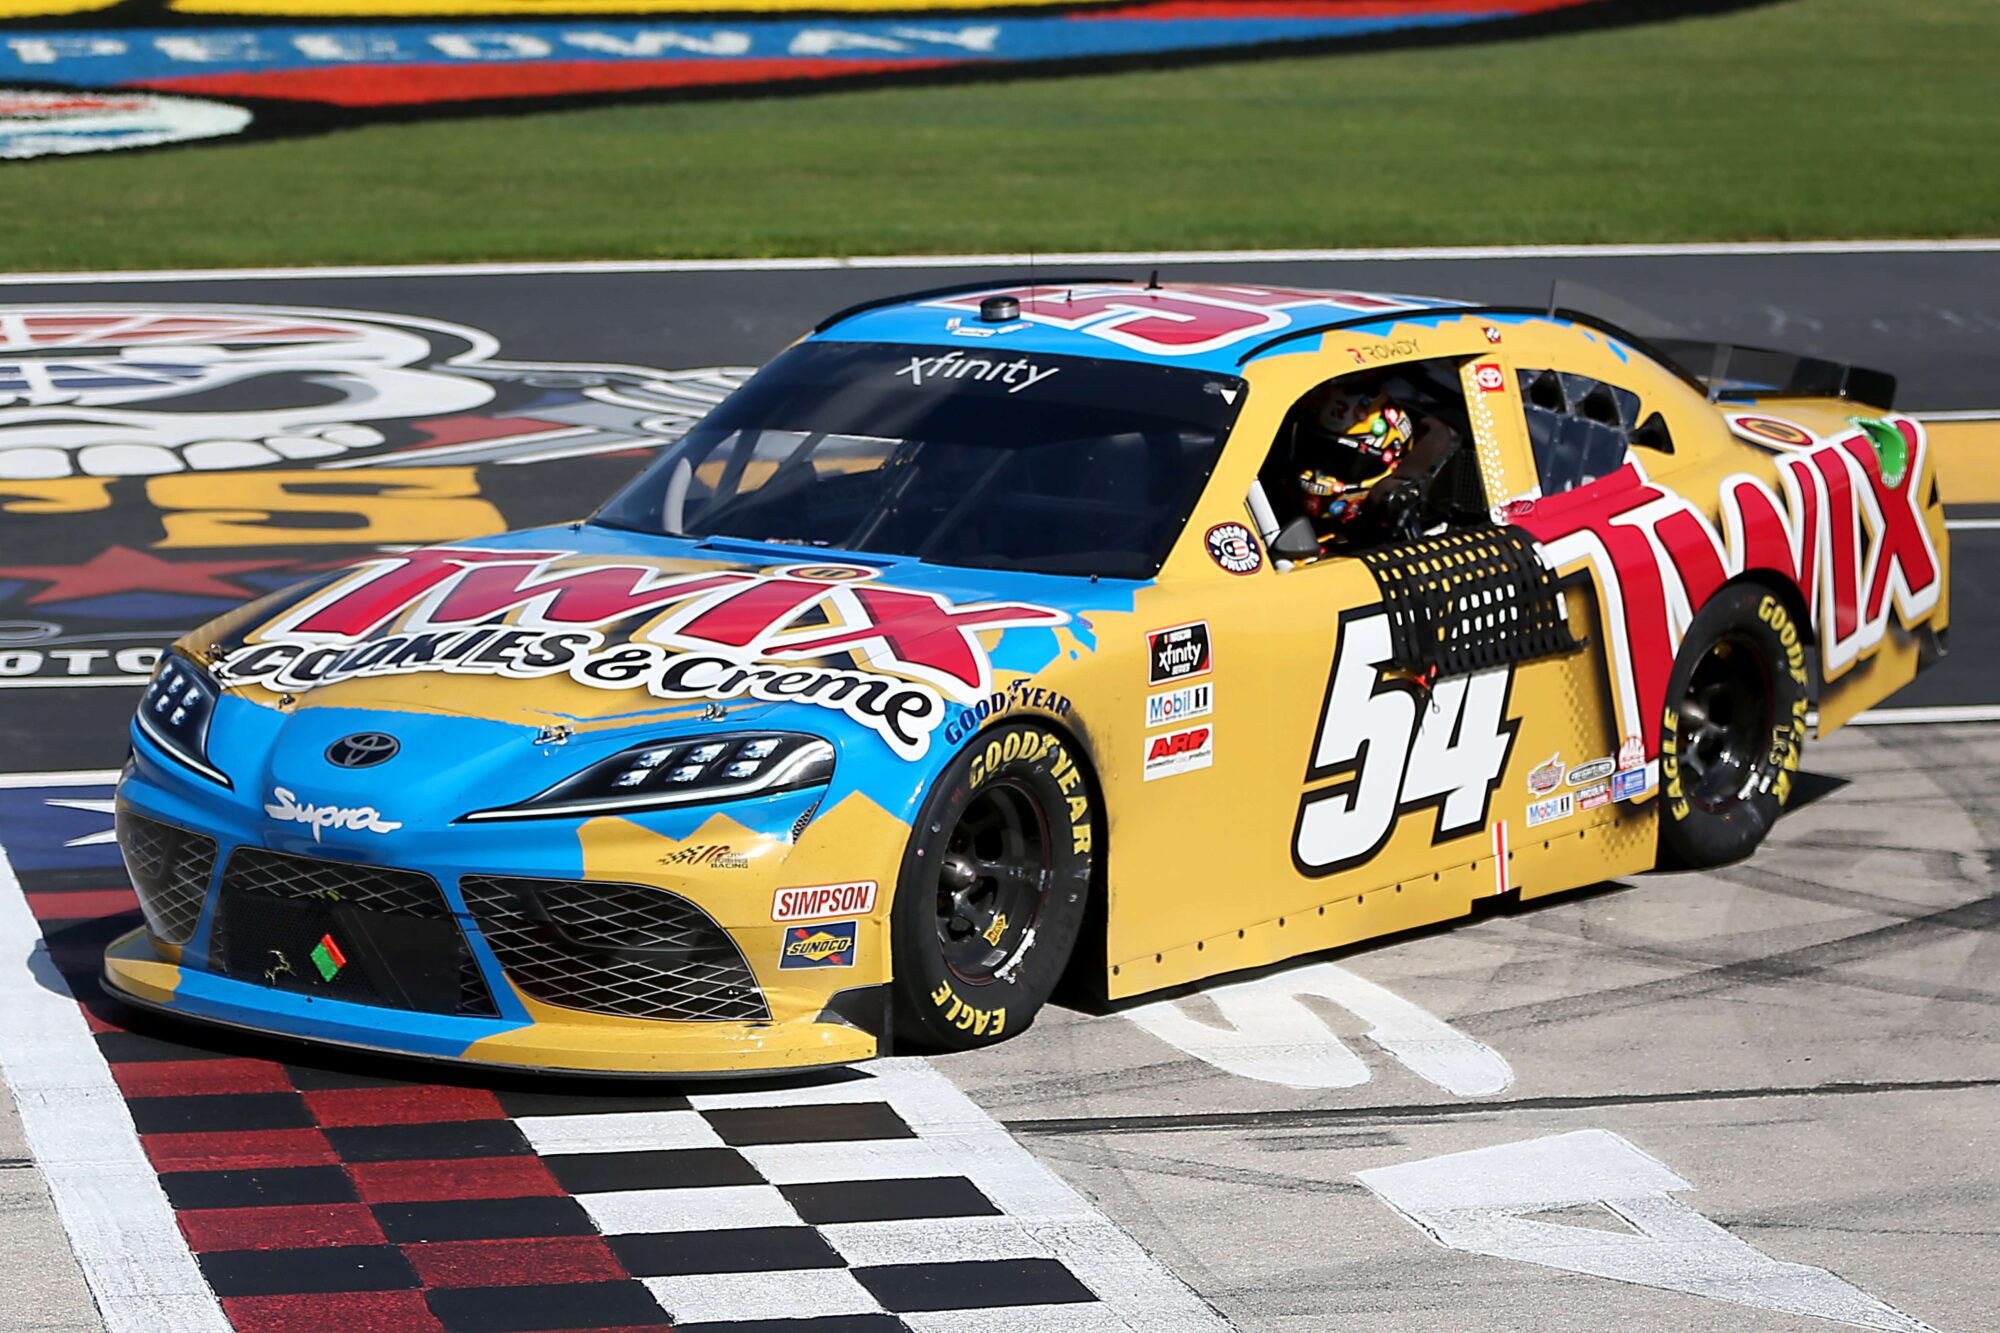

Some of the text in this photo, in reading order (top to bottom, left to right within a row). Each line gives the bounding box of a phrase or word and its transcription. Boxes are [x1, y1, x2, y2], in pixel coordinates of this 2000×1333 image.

[895, 350, 1060, 395] xfinity
[1220, 551, 1260, 572] SALUTES
[1158, 641, 1202, 672] xfinity
[223, 629, 933, 747] COOKIES & Creme
[945, 678, 1072, 746] GOODYEAR
[1150, 690, 1191, 719] Mobil
[1195, 687, 1208, 709] 1
[1757, 594, 1809, 807] GOODYEAR
[1148, 728, 1210, 761] ARP
[1293, 604, 1520, 877] 54
[1662, 705, 1691, 822] EAGLE
[264, 787, 402, 843] Supra
[968, 730, 1092, 856] GOODYEAR
[1529, 800, 1558, 818] Mobil
[778, 885, 870, 917] SIMPSON
[789, 937, 850, 955] SUNOCO
[929, 979, 1007, 1037] EAGLE
